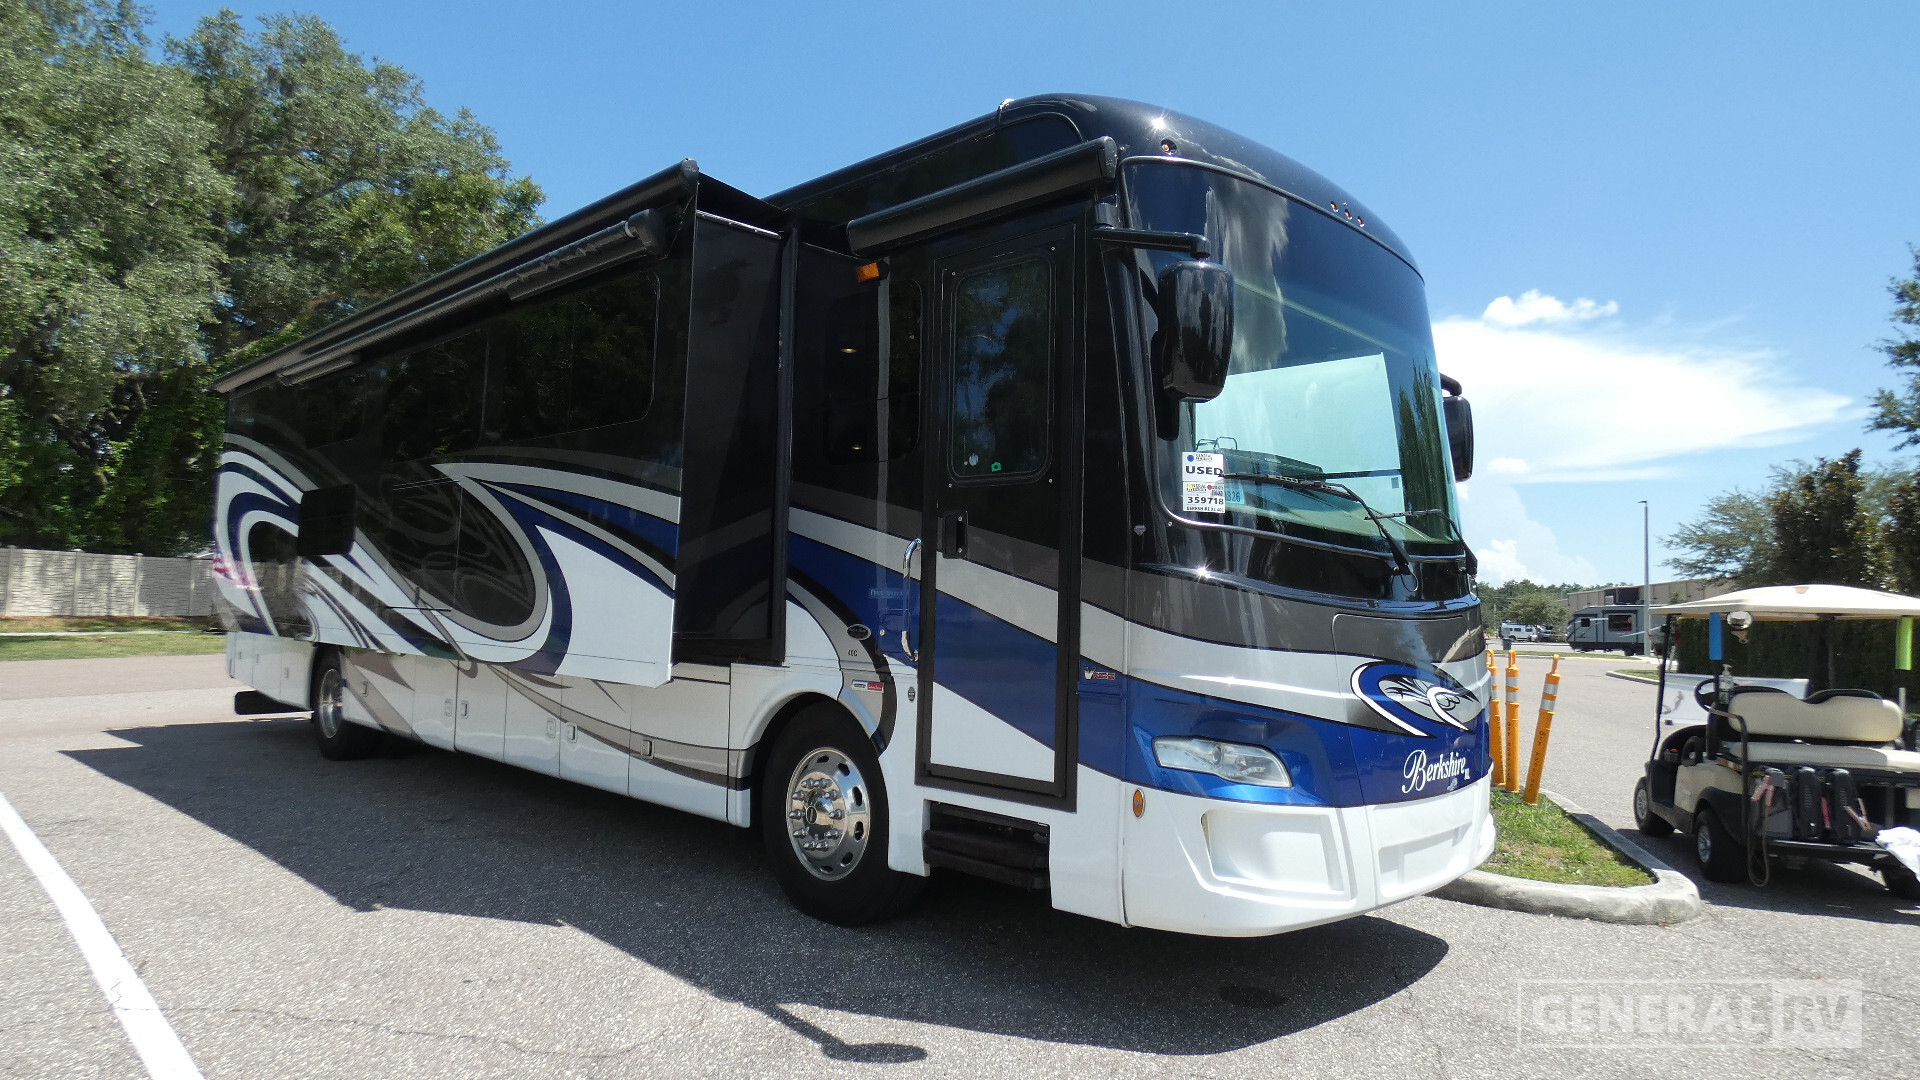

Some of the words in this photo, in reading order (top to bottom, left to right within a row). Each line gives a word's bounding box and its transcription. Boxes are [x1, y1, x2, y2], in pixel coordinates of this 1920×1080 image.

[1185, 465, 1223, 476] USED
[1187, 496, 1224, 505] 359718
[1401, 749, 1466, 794] Berkshire
